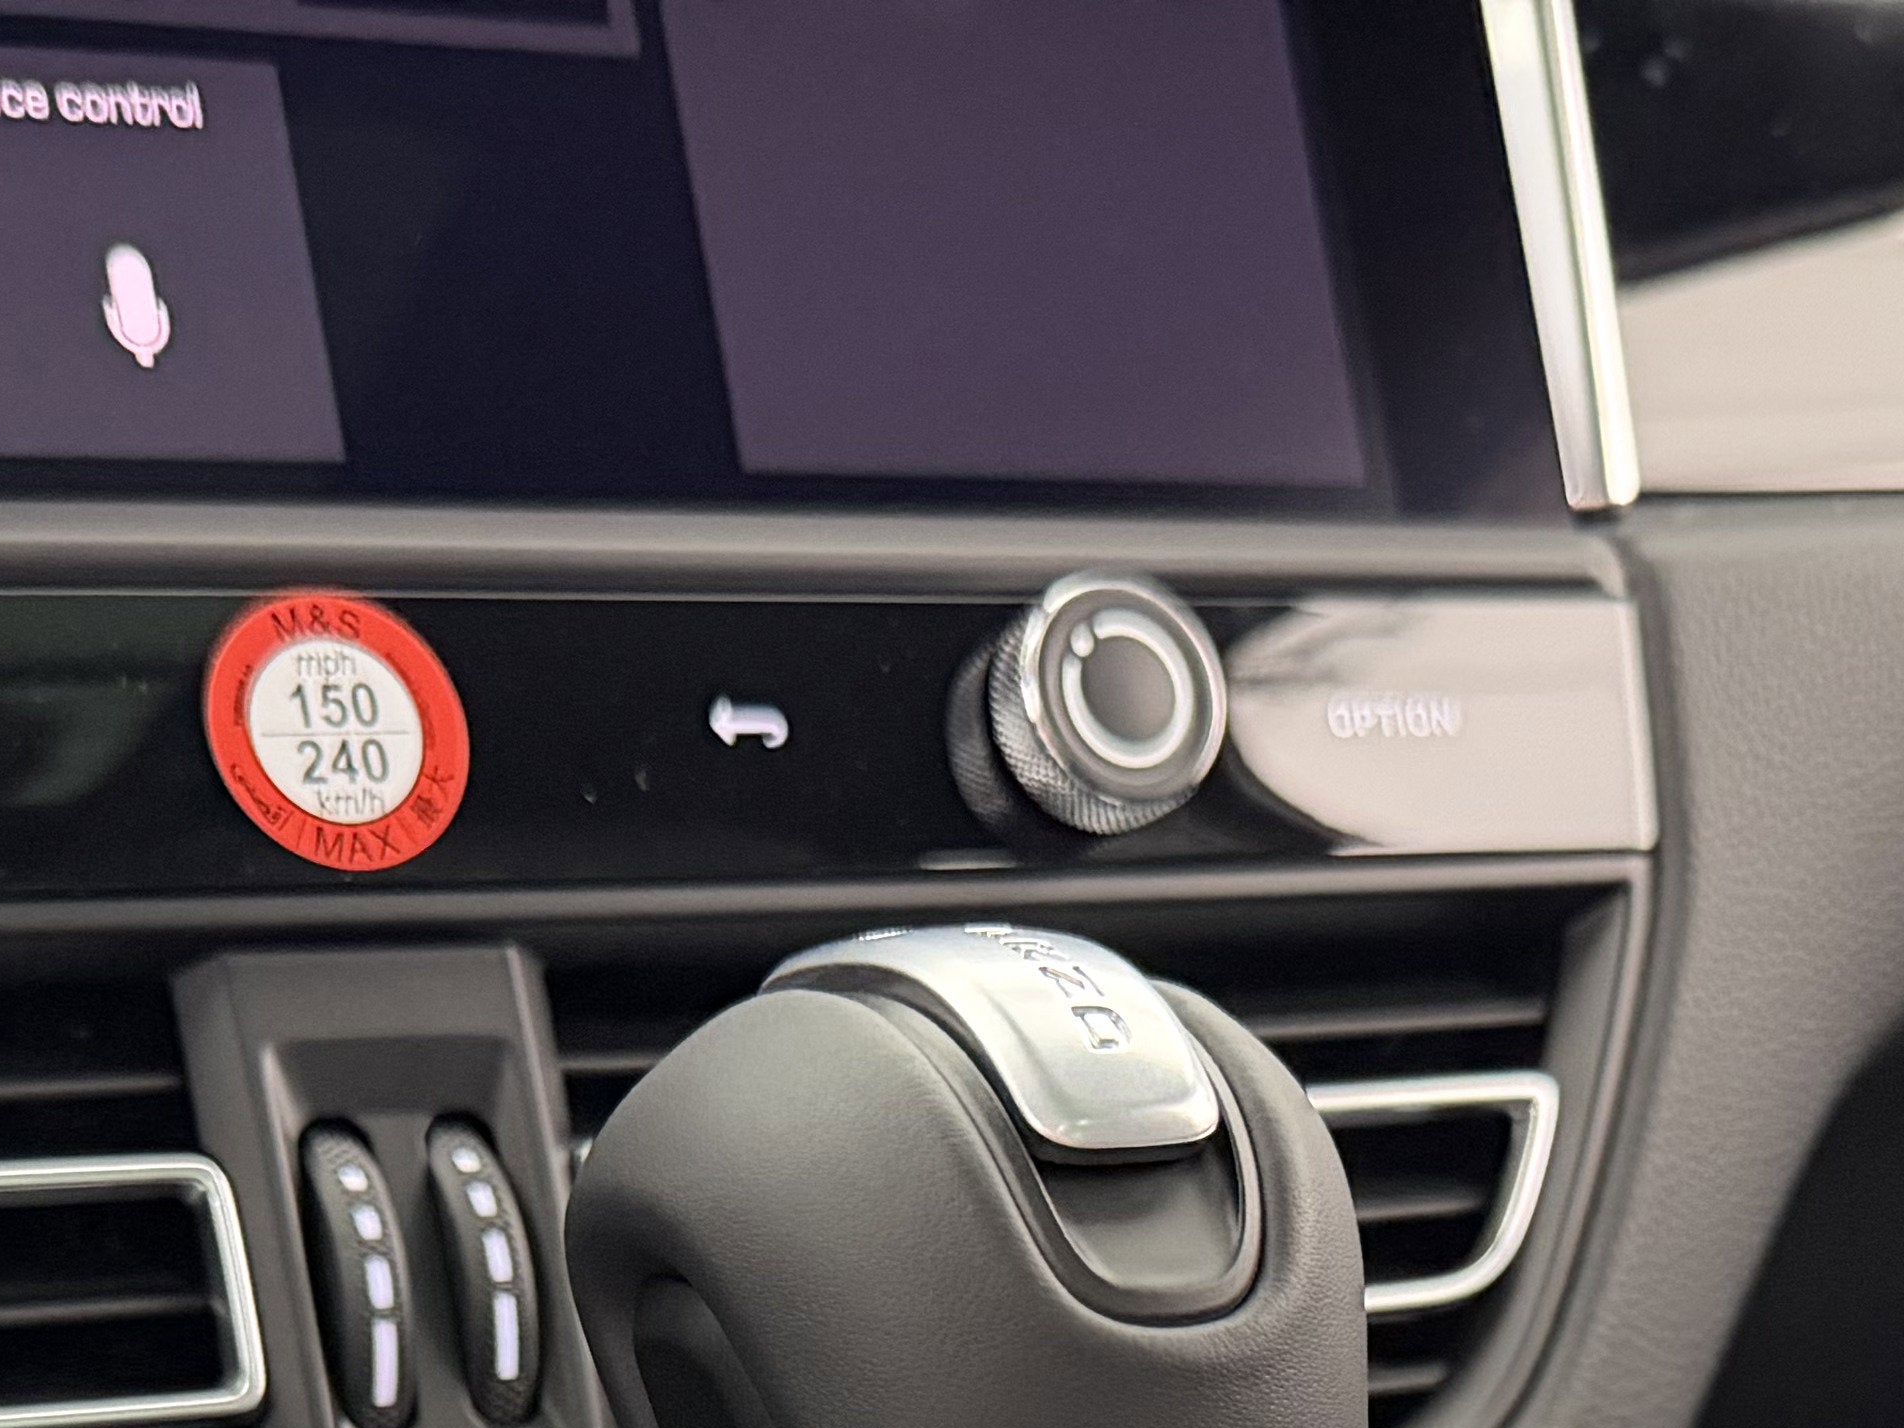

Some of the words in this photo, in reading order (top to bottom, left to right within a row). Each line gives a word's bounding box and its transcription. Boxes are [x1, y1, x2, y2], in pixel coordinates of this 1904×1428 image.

[54, 81, 203, 130] control
[270, 603, 362, 641] M&S
[289, 682, 380, 729] 150
[1326, 690, 1462, 738] OPTION
[296, 738, 391, 785] 240
[312, 786, 387, 817] km/h
[313, 825, 402, 864] MAX
